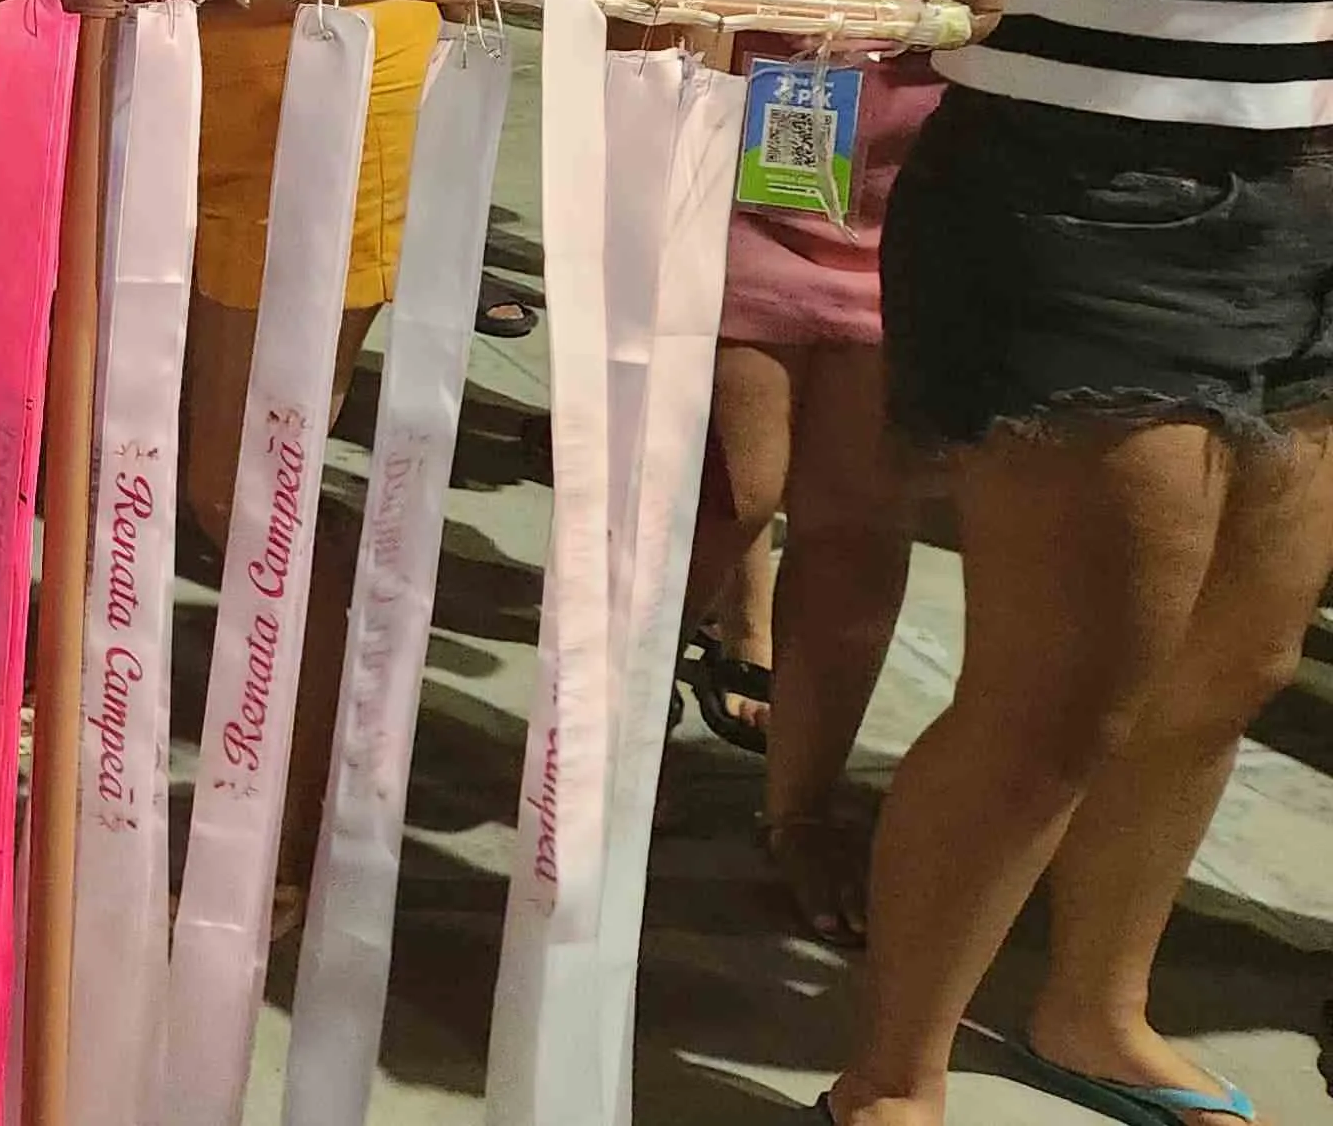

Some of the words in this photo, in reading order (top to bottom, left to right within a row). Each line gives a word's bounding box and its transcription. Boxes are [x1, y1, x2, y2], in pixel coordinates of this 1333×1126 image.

[108, 473, 154, 630] Renata
[248, 437, 306, 598] Campeã
[88, 646, 144, 804] Campeã
[223, 614, 280, 771] Renata
